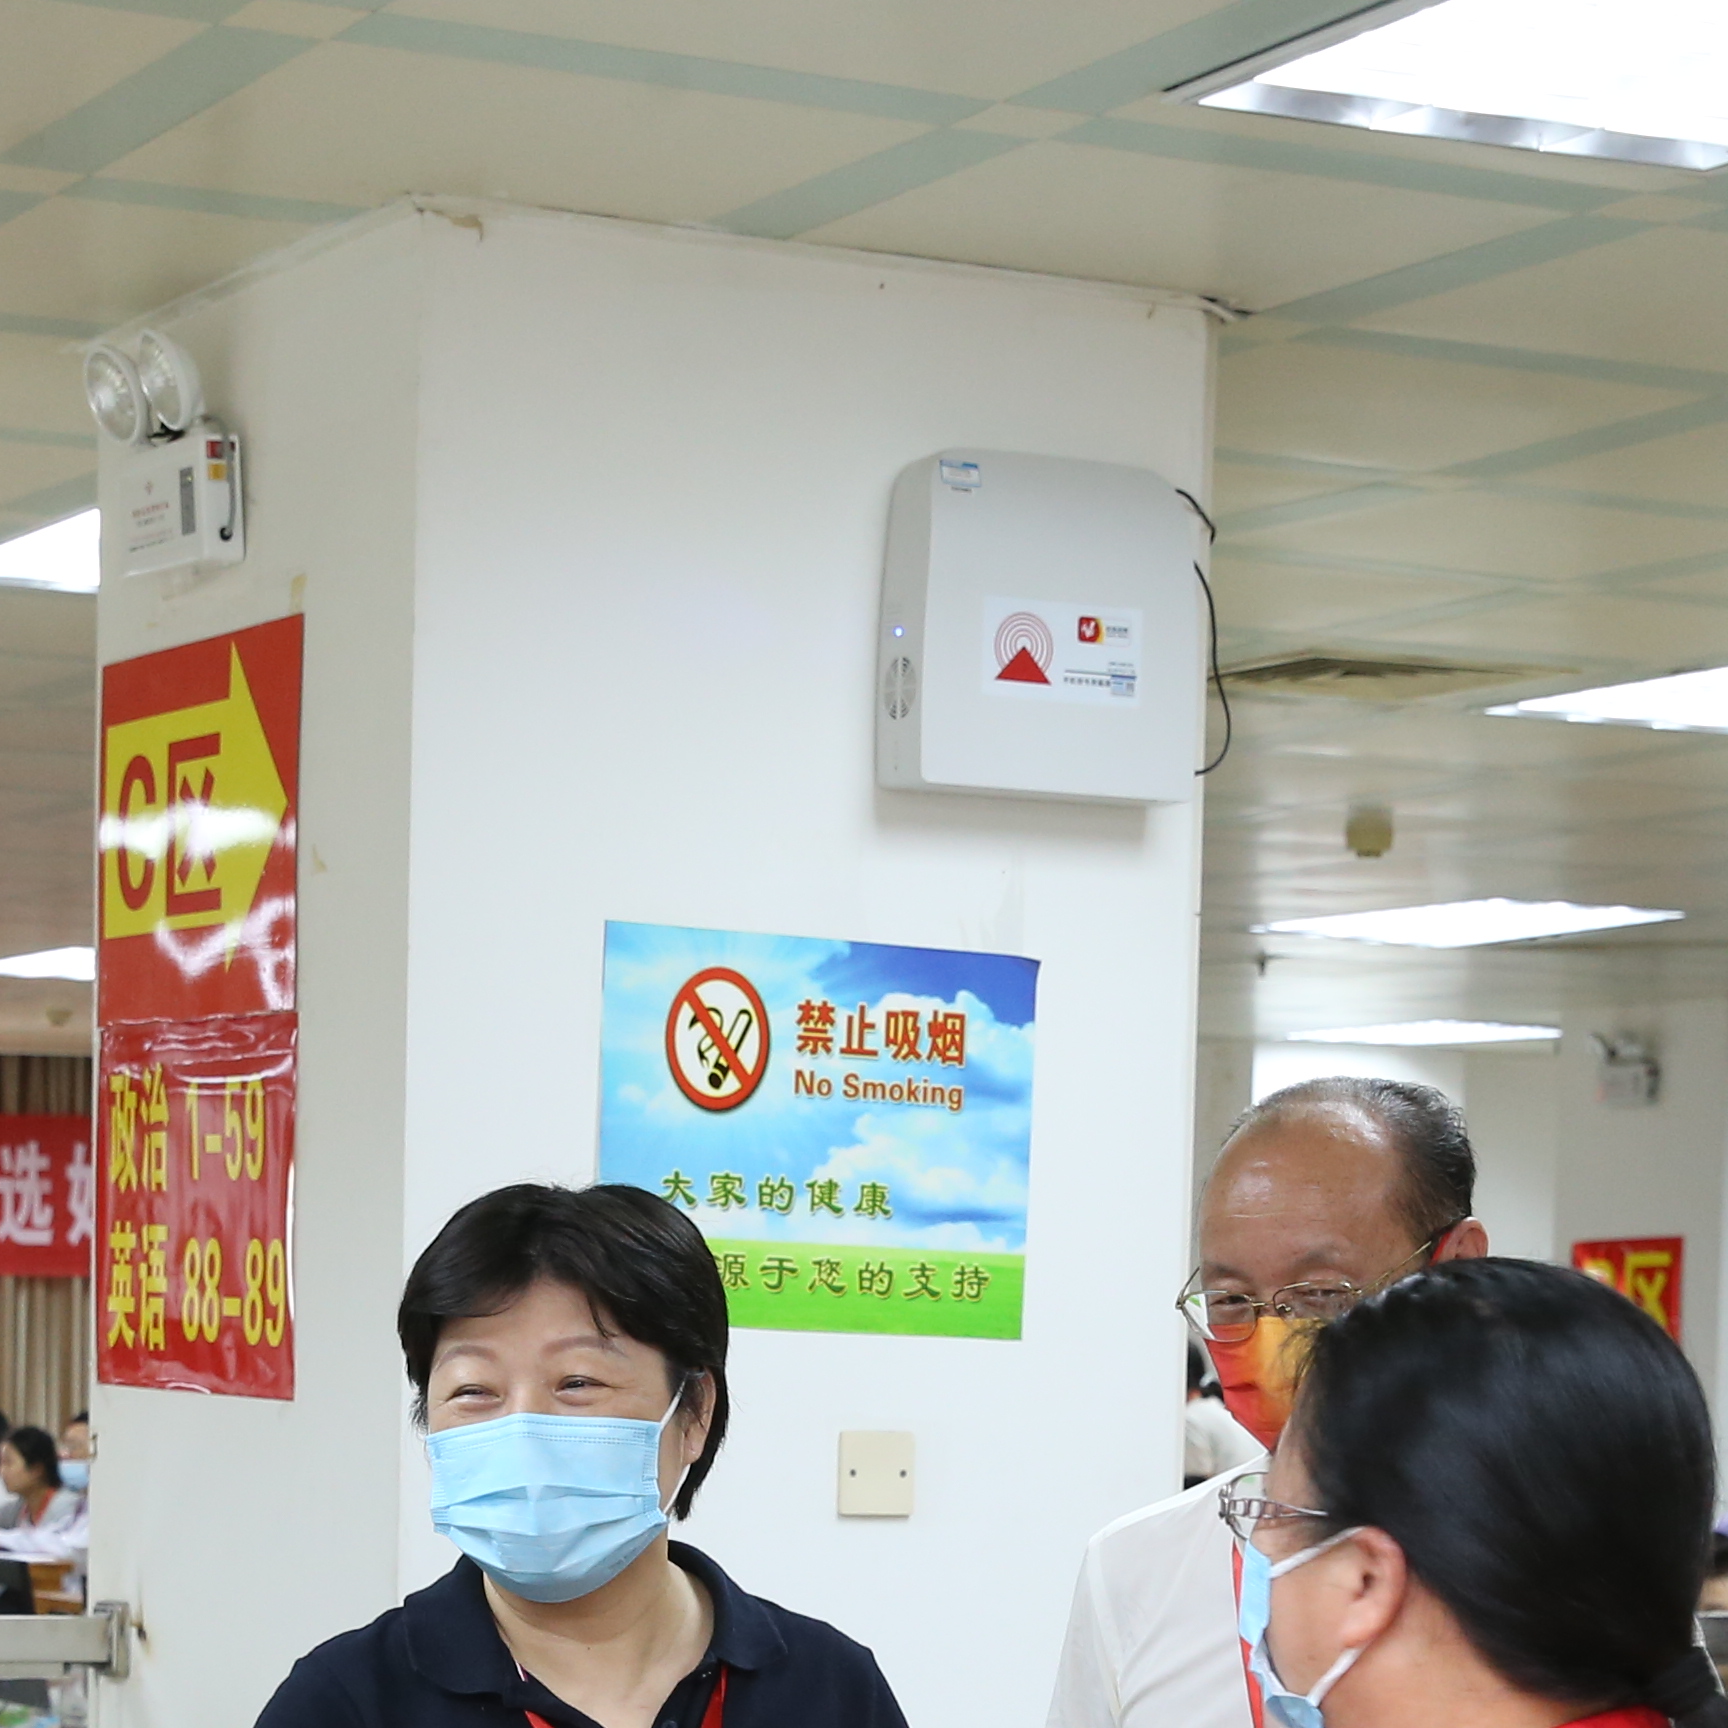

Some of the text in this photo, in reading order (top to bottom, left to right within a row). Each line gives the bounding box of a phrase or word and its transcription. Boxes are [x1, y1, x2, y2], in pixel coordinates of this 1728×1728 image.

[118, 732, 222, 917] C区
[795, 999, 966, 1067] 禁止吸烟
[794, 1069, 964, 1112] No Smoking
[109, 1061, 265, 1194] 政治 1-59
[661, 1171, 892, 1218] 大家的健康
[107, 1220, 286, 1351] 英语 88-89
[715, 1254, 990, 1302] 源于您的支持
